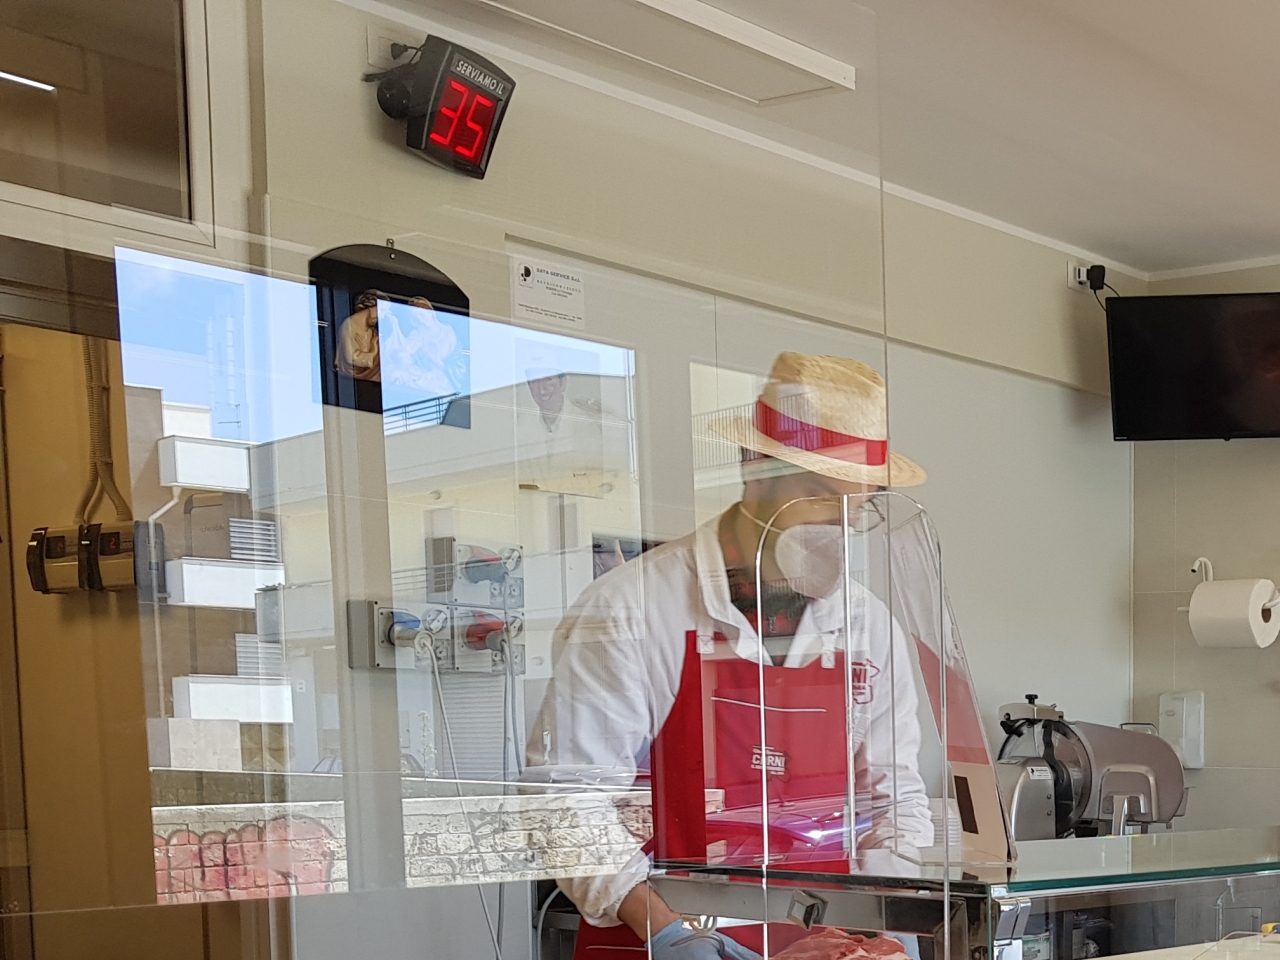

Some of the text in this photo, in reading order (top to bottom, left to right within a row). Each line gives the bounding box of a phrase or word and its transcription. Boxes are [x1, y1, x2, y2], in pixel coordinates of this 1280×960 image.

[456, 60, 504, 95] SERVIAMO IL
[429, 80, 493, 158] 35
